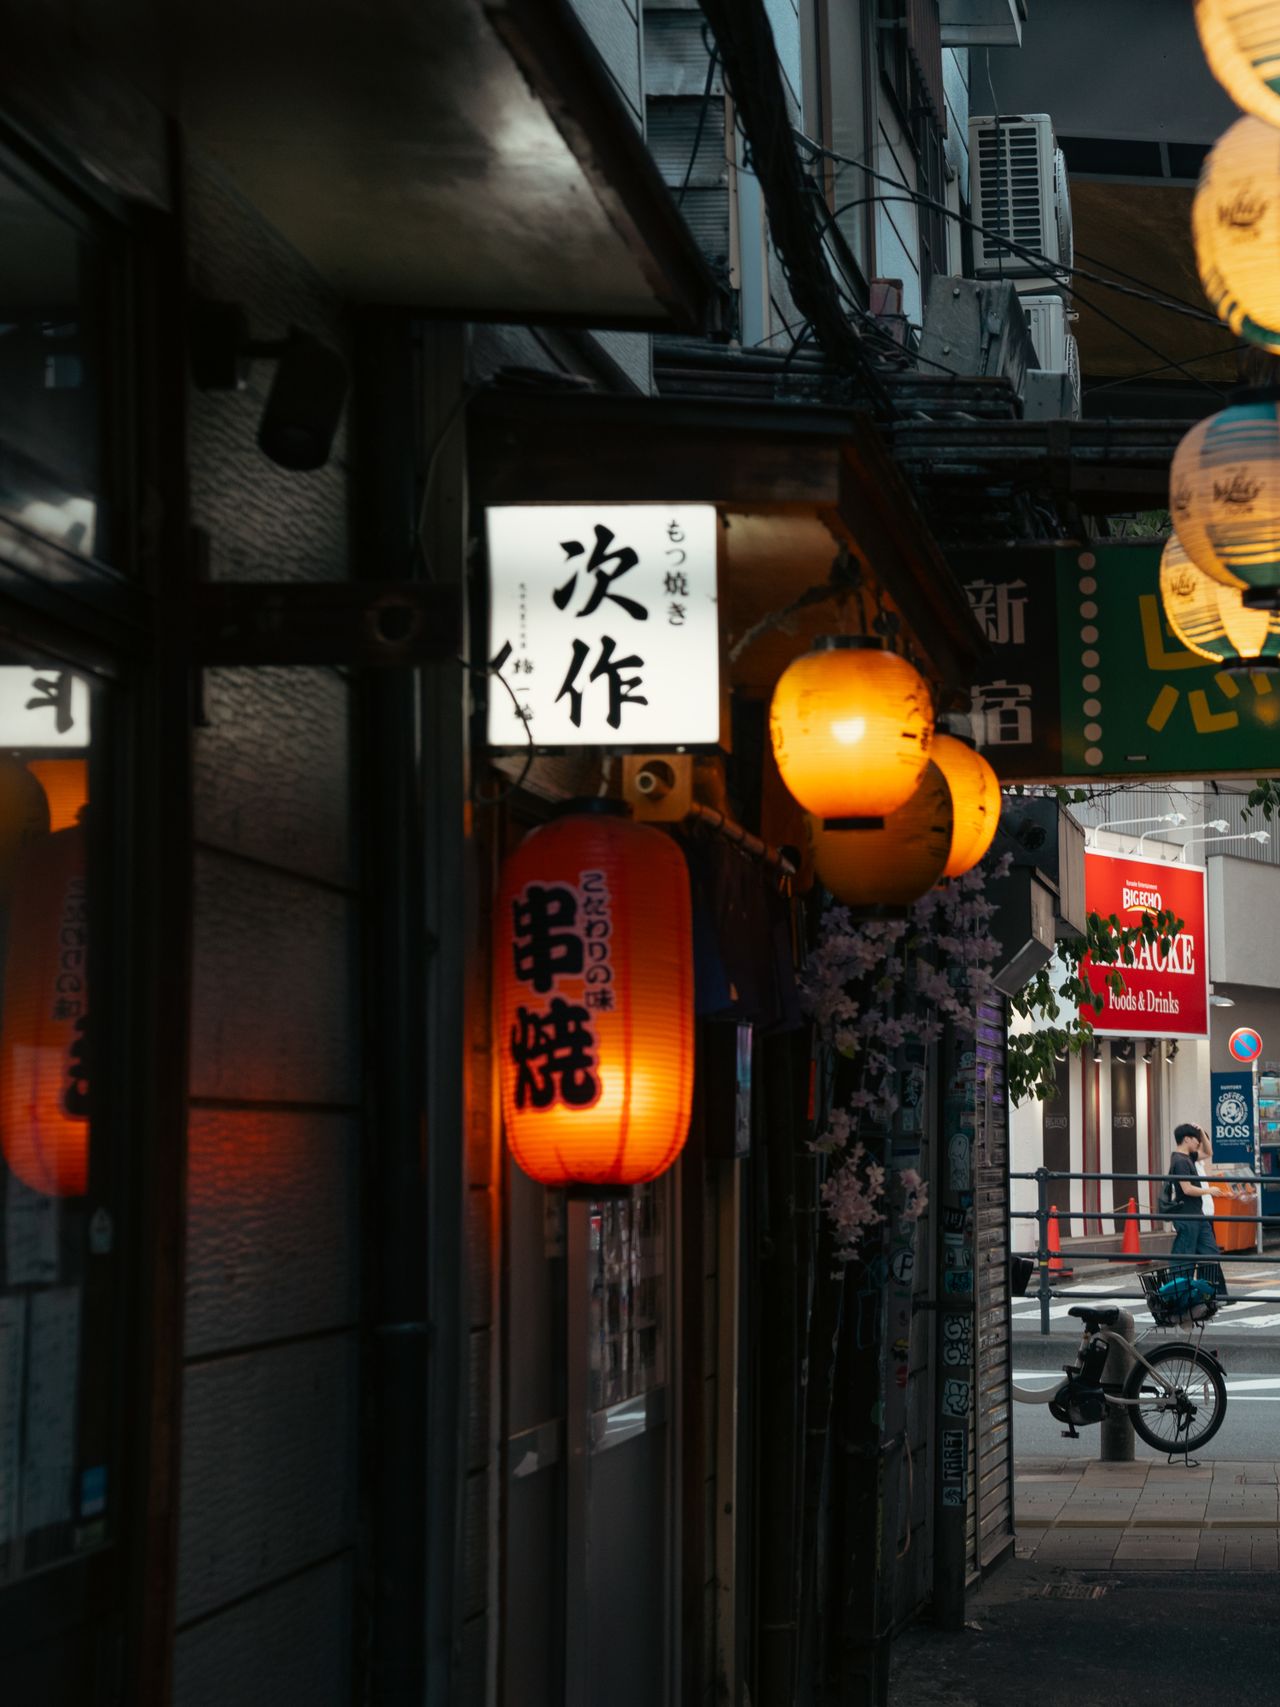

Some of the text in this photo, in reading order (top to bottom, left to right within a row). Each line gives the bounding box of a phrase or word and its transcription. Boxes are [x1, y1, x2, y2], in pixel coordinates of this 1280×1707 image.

[664, 519, 689, 626] もつ焼き
[553, 524, 649, 729] 次作
[963, 578, 1033, 745] 新宿
[583, 872, 613, 1011] こだわりの味
[1090, 926, 1195, 975] AOKE
[1123, 887, 1162, 912] BIG ECHO
[512, 885, 597, 1110] 串焼
[1138, 990, 1146, 1011] &
[1146, 989, 1180, 1015] Drinks
[1216, 1125, 1250, 1138] BOSS
